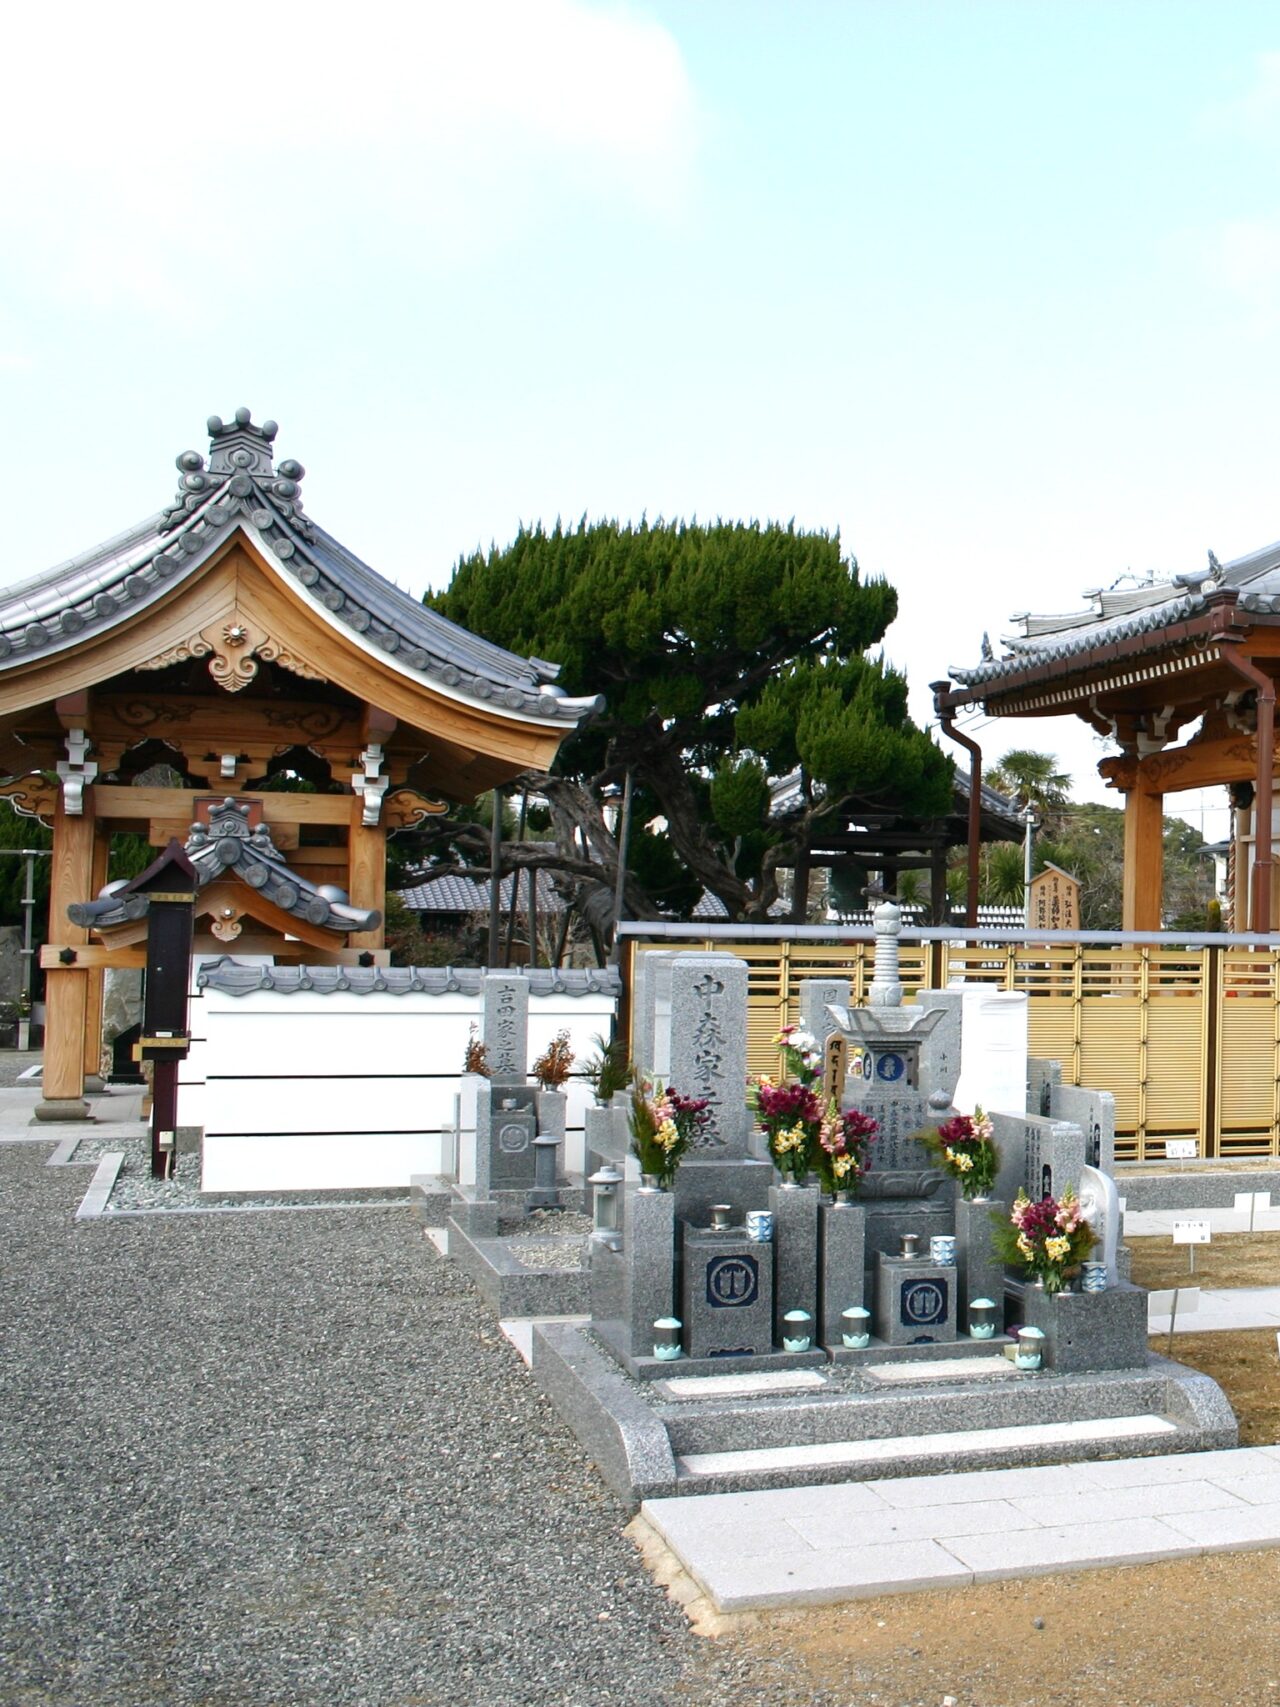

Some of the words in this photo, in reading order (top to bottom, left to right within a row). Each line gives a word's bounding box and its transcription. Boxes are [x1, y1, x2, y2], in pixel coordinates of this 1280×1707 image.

[495, 984, 520, 1075] 吉田家之墓
[692, 973, 728, 1150] 中森家之墓
